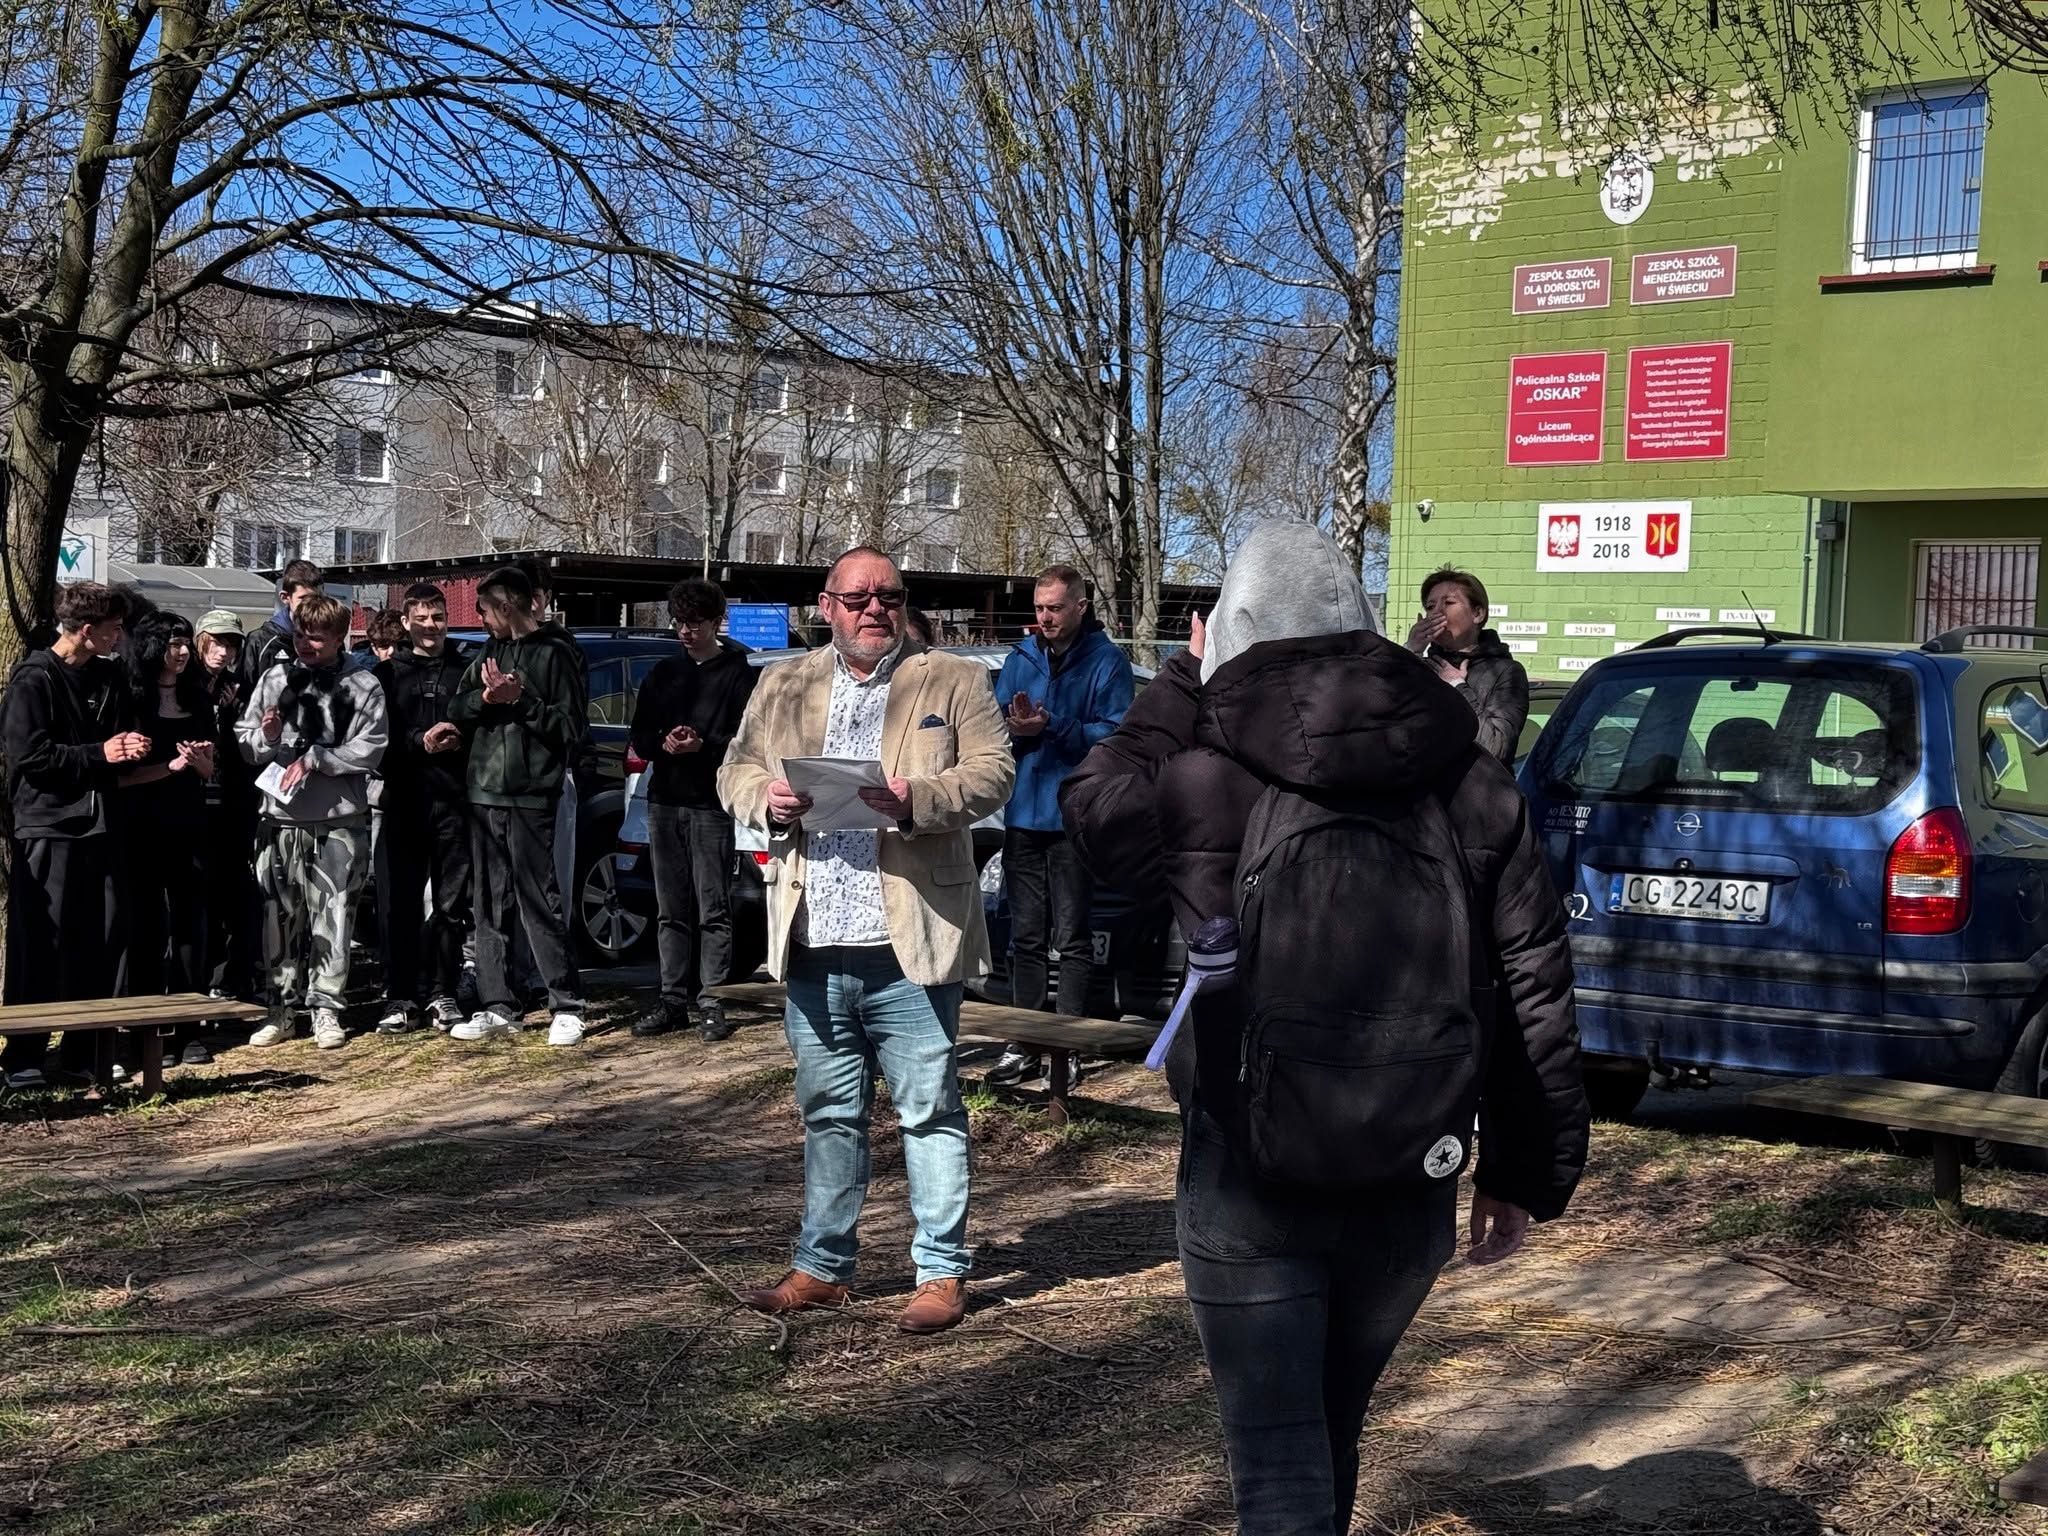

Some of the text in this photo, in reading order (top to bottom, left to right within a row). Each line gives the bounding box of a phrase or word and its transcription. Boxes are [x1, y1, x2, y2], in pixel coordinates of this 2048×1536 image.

[1647, 254, 1721, 272] ZESPÓŁ SZKÓŁ
[1528, 266, 1596, 283] ZESPÓŁ SZKÓŁ
[1642, 268, 1725, 285] MENEDŻERSKICH
[1523, 279, 1600, 296] DLA DOROSŁYCH
[1656, 282, 1709, 297] W ŚWIECIU
[1536, 293, 1586, 307] W ŚWIECIU
[1515, 371, 1601, 386] Policealna Szkoła
[1538, 421, 1572, 431] Liceum
[1515, 432, 1596, 446] Ogólnokształcące
[1594, 515, 1632, 532] 1918
[1592, 543, 1631, 559] 2018
[1628, 876, 1760, 913] CG 2243C
